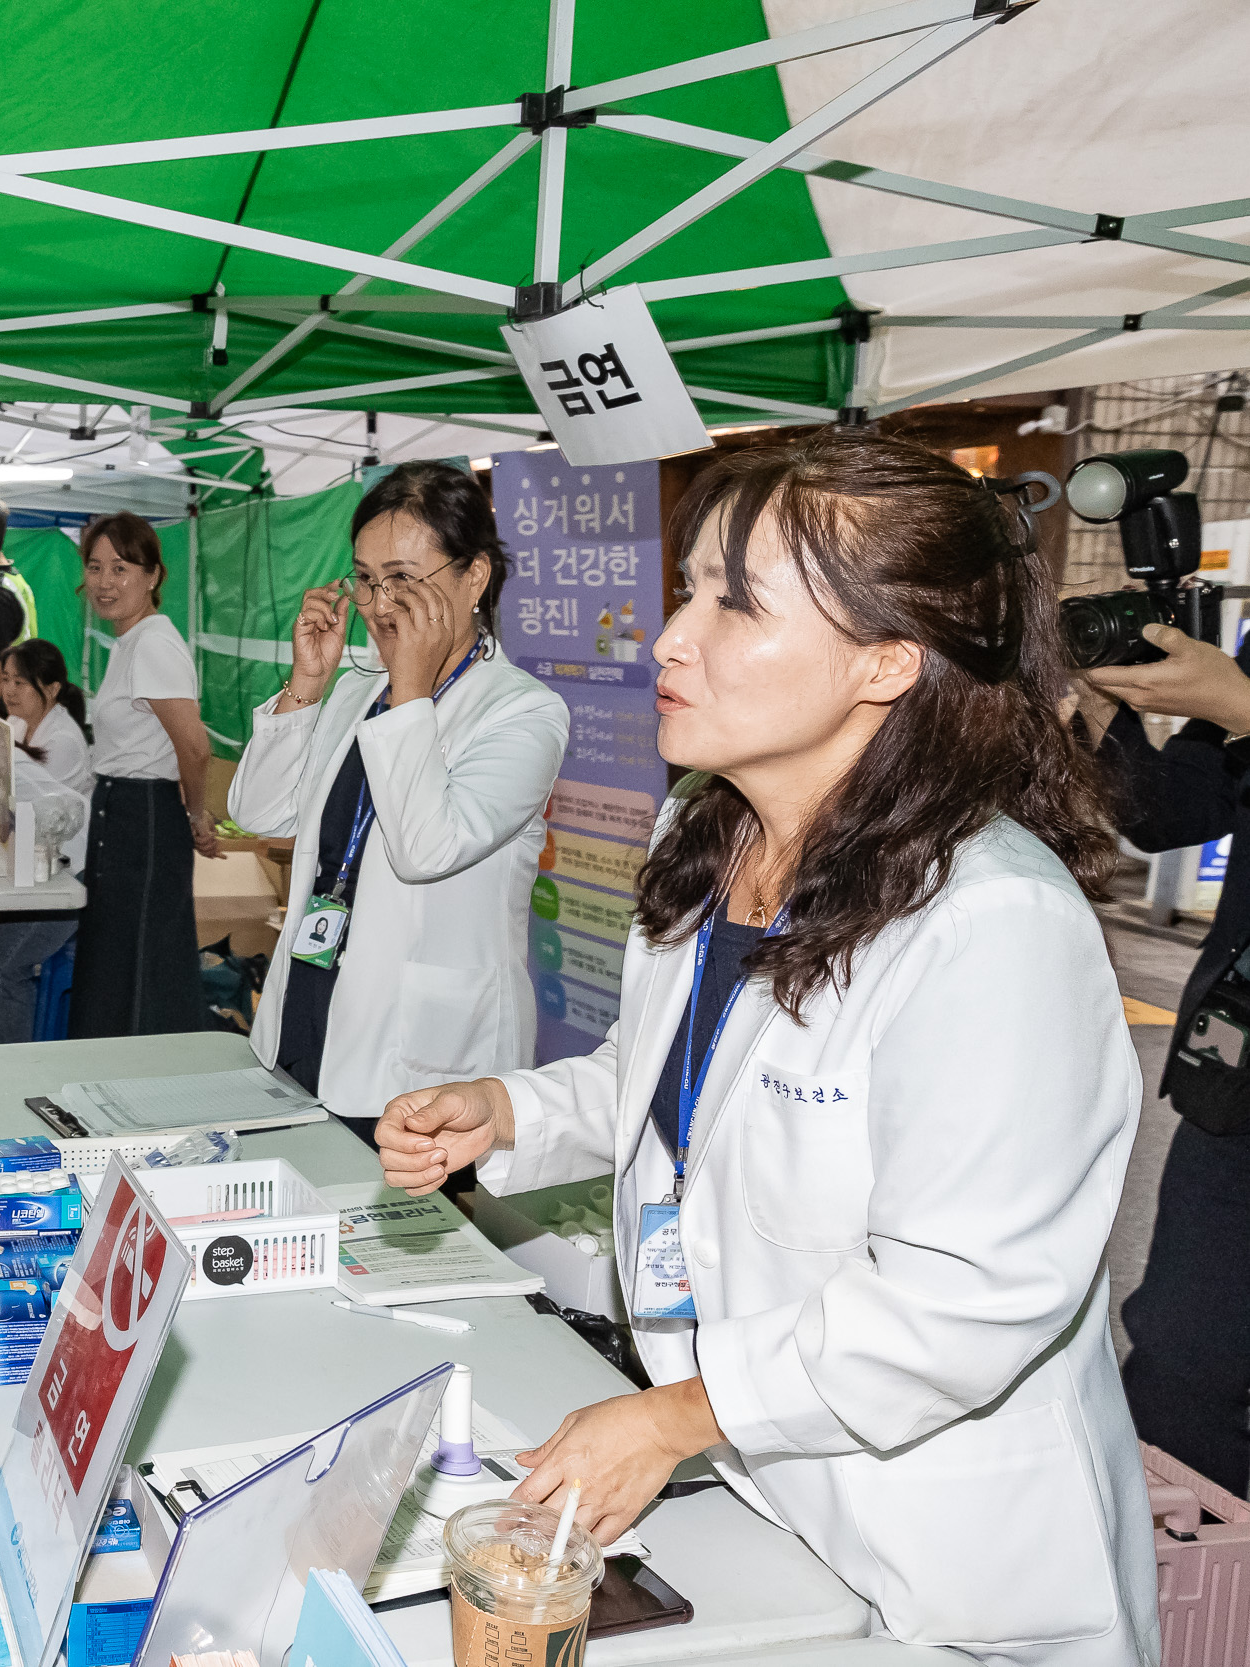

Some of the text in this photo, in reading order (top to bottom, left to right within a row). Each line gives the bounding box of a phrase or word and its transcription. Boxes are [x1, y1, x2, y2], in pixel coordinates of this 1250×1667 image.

[540, 343, 643, 417] 금연
[514, 491, 635, 536] 싱거워서
[517, 545, 640, 587] 더 건강한
[518, 597, 579, 637] 광진!
[11, 1207, 45, 1219] 니코틴엘
[212, 1246, 235, 1257] step
[212, 1256, 244, 1268] basket
